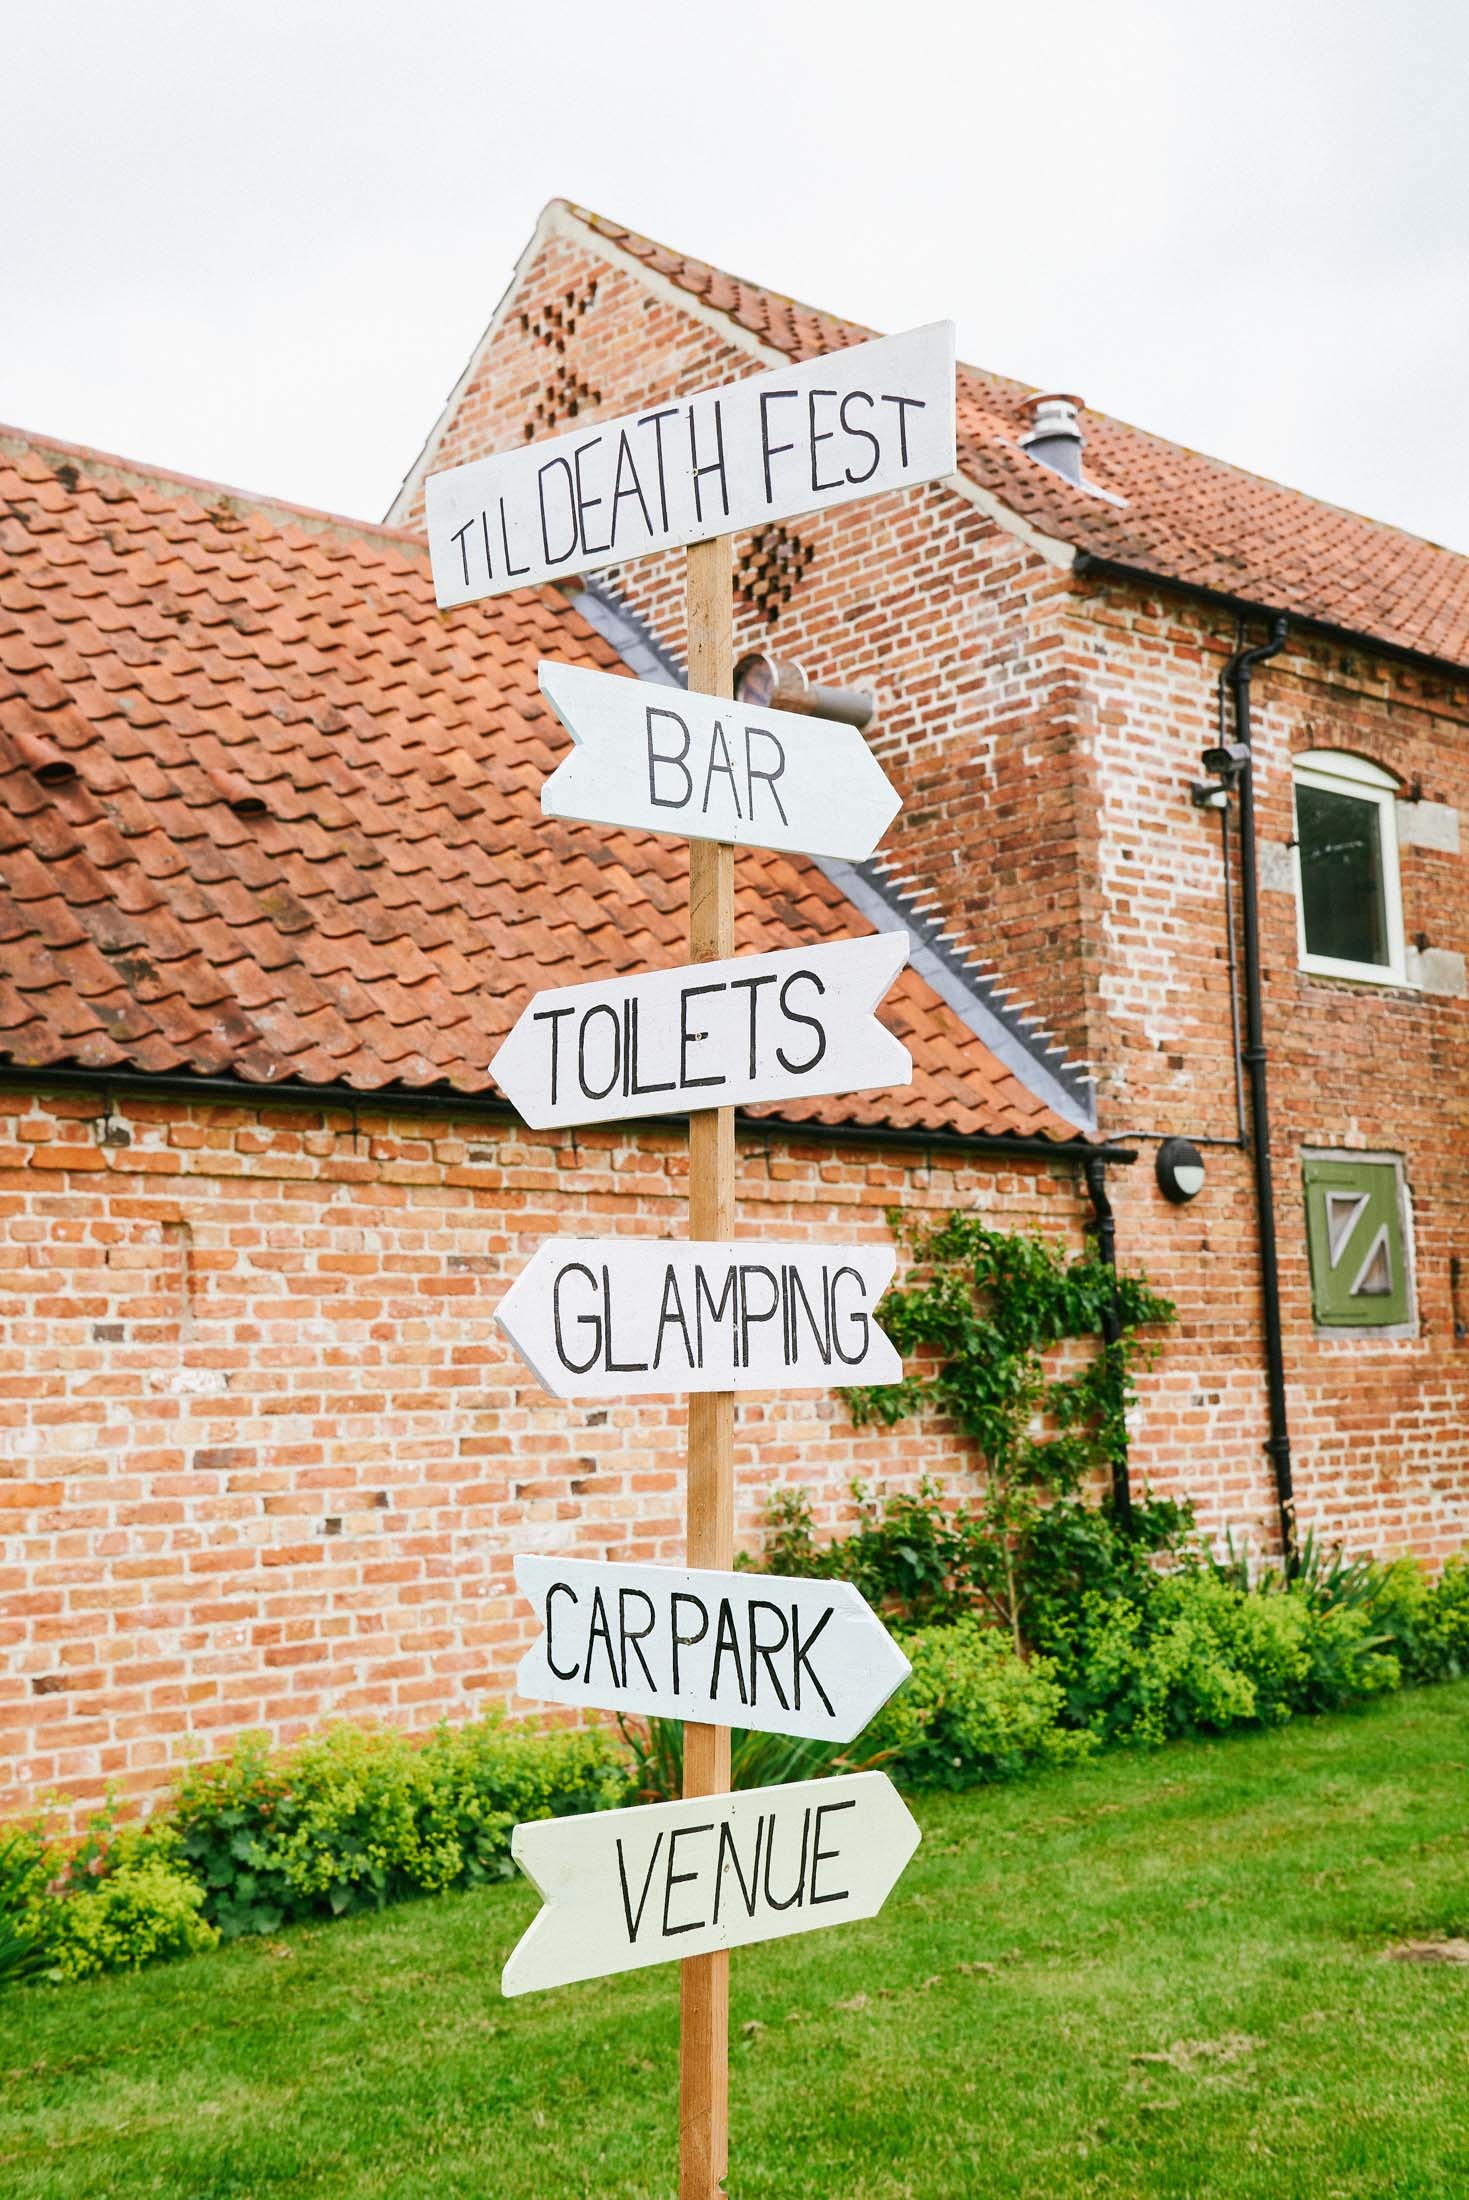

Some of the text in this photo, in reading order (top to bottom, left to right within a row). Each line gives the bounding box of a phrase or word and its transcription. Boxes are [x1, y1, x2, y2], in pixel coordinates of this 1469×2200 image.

[450, 389, 926, 586] TIL DEATH FEST
[645, 706, 789, 826] BAR
[533, 969, 827, 1106] TOILETS
[553, 1262, 869, 1374] GLAMPING
[546, 1582, 836, 1718] CAR PARK
[616, 1799, 856, 1944] VENUE
